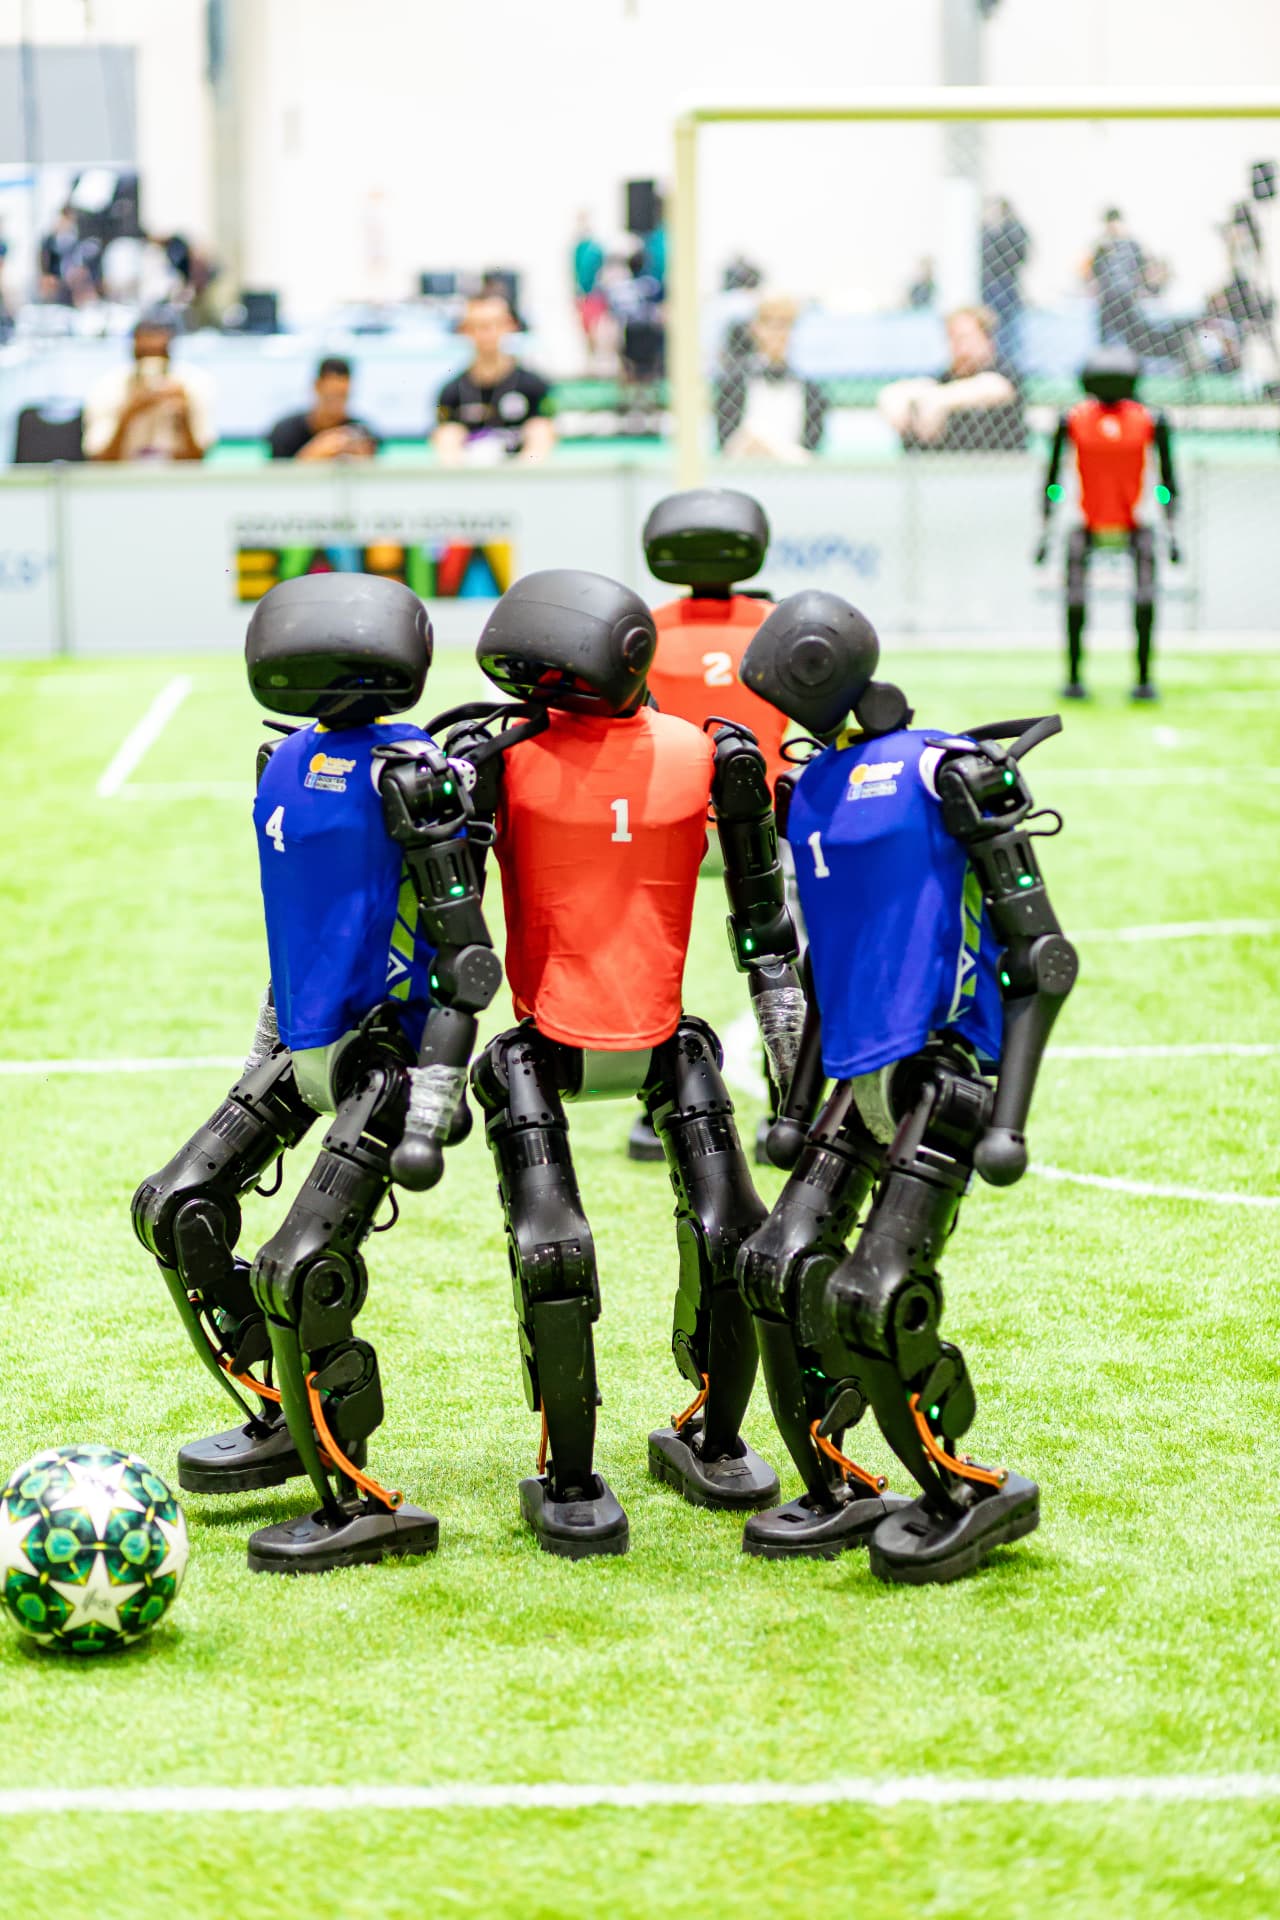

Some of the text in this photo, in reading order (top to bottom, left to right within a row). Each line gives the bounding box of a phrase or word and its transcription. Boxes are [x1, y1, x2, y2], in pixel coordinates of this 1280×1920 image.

[702, 652, 733, 687] 2
[265, 805, 286, 853] 4
[610, 798, 633, 842] 1
[807, 831, 830, 878] 1
